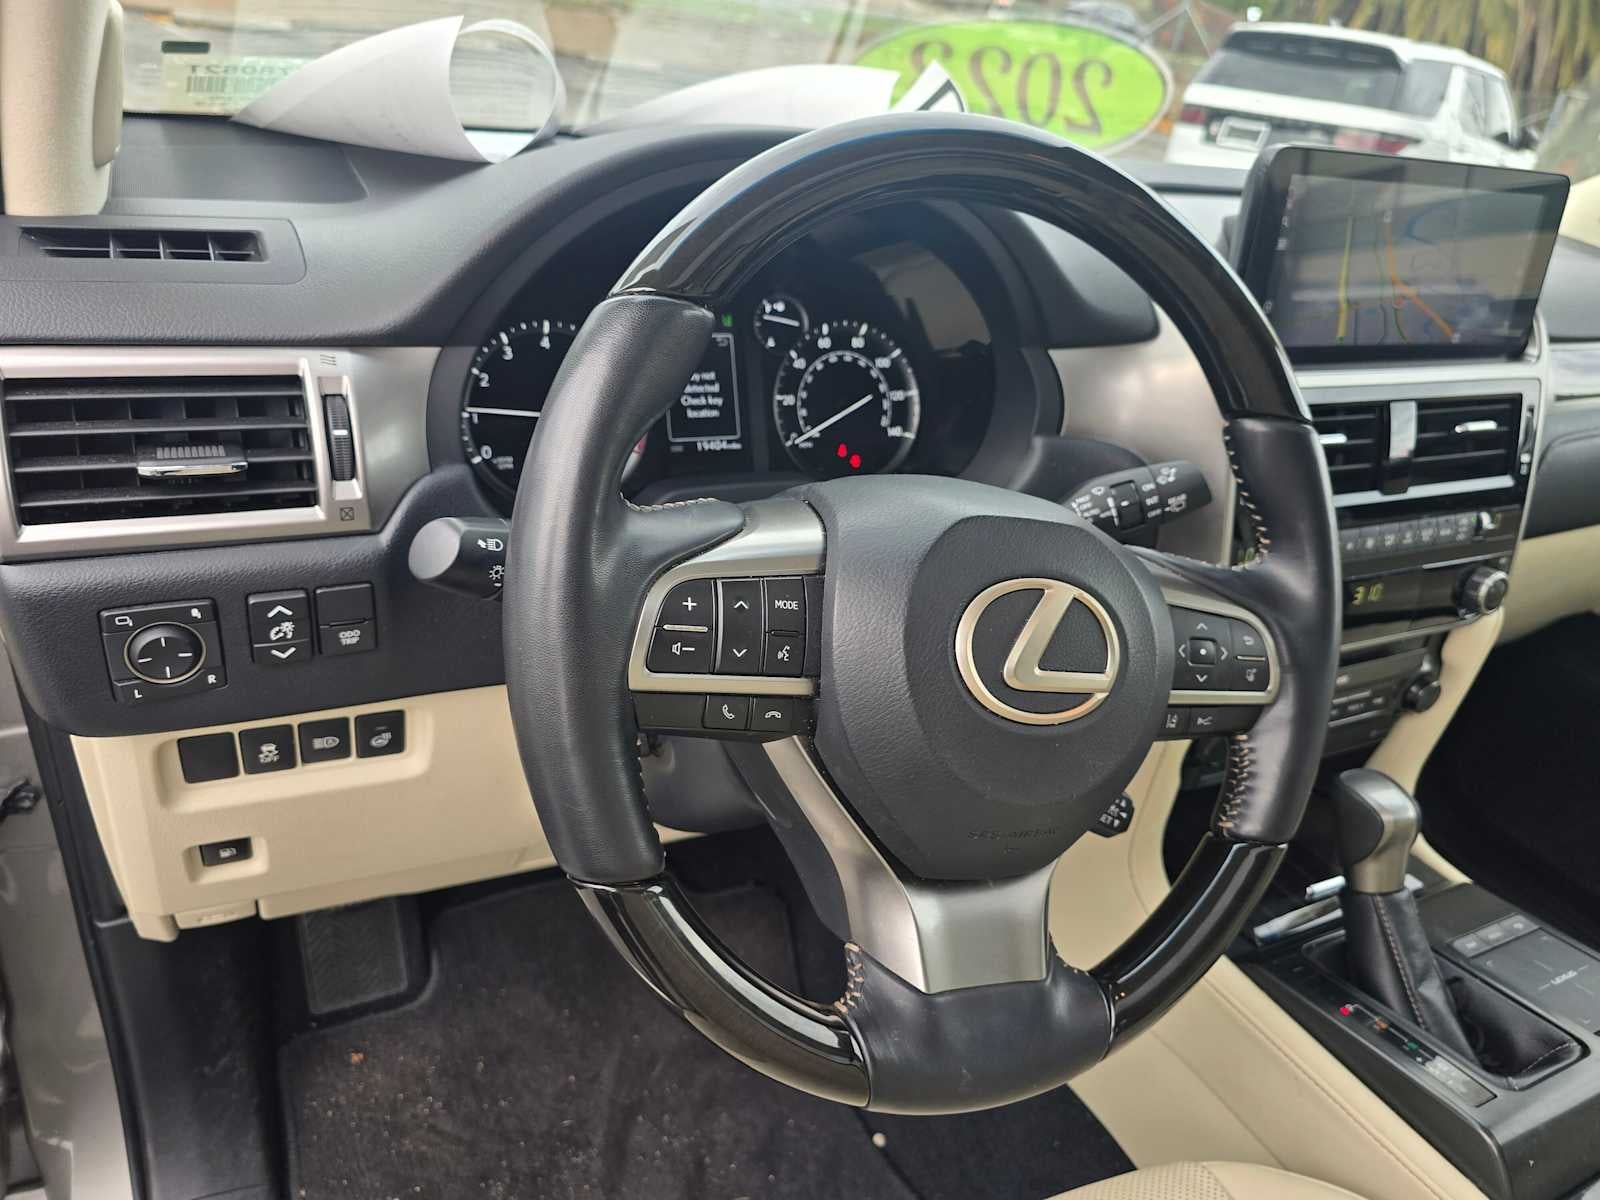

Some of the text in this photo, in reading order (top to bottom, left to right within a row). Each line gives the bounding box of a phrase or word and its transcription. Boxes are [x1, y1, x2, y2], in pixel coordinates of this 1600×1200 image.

[540, 336, 551, 350] 4
[502, 346, 514, 360] 3
[479, 372, 489, 387] 2
[481, 445, 493, 459] 0
[774, 599, 799, 611] MODE
[338, 629, 361, 639] ODO
[207, 674, 217, 684] R
[133, 688, 143, 699] L
